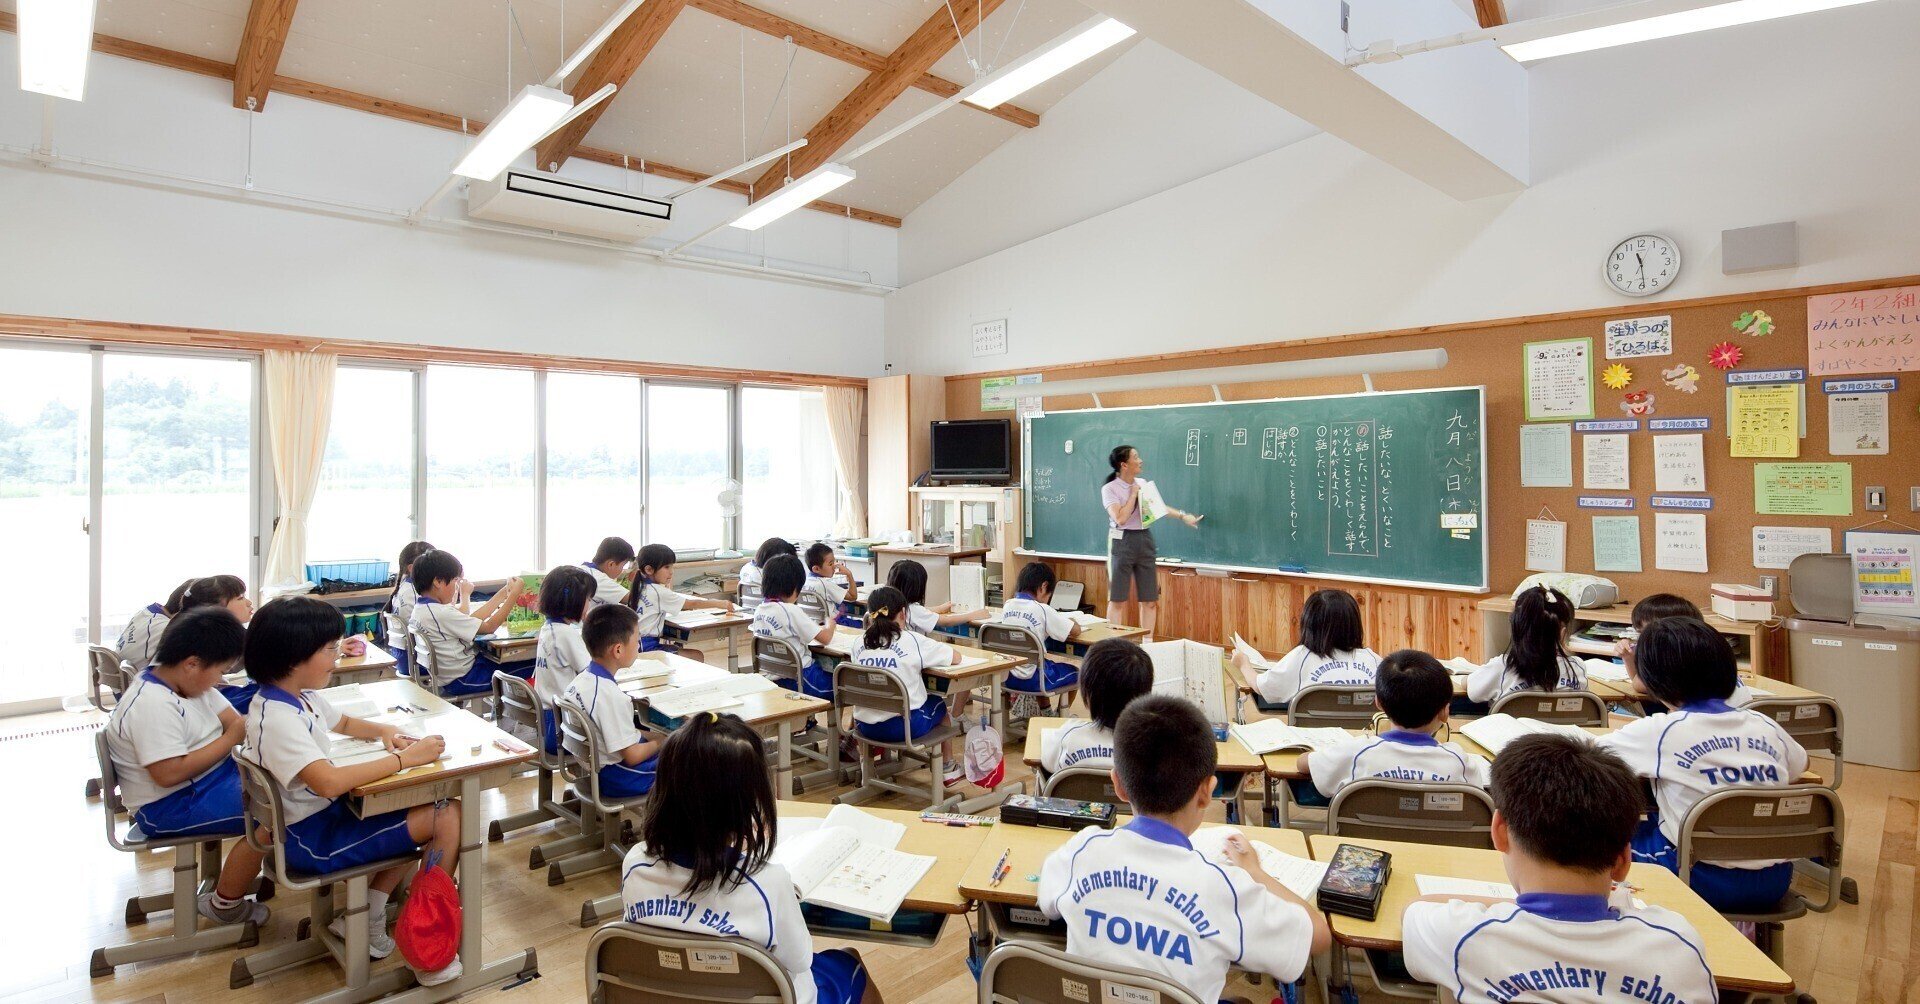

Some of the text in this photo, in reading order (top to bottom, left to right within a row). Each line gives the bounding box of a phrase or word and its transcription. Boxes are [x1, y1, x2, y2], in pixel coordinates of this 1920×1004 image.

[1625, 243, 1633, 252] 11
[1637, 239, 1646, 248] 12
[1661, 246, 1667, 255] 2
[1616, 252, 1625, 261] 10
[1664, 257, 1671, 266] 3
[1612, 263, 1620, 272] 9
[1660, 269, 1667, 277] 4
[1616, 273, 1623, 282] 8
[1651, 277, 1659, 287] 5
[1626, 280, 1632, 289] 7
[1638, 281, 1646, 290] 6
[1830, 292, 1920, 314] 2年2組
[1621, 340, 1660, 353] ひろば
[1814, 333, 1914, 351] よくかんがえる
[1816, 355, 1920, 372] すばやくこうど
[1839, 381, 1881, 390] 今月のうた
[1661, 420, 1706, 429] 今月のめあて
[1187, 430, 1199, 464] おわり
[1342, 426, 1357, 552] どんなことをくわしく話す
[1378, 424, 1394, 549] 話したいな、とくいなこと
[859, 657, 898, 669] TOWA
[1310, 659, 1377, 683] elementary school
[1064, 743, 1114, 767] elementar
[1673, 734, 1741, 770] elementary
[1699, 764, 1779, 786] TOWA
[1072, 866, 1220, 939] elementary school
[1084, 908, 1193, 966] TOWA
[695, 952, 703, 961] L
[1111, 986, 1120, 997] L
